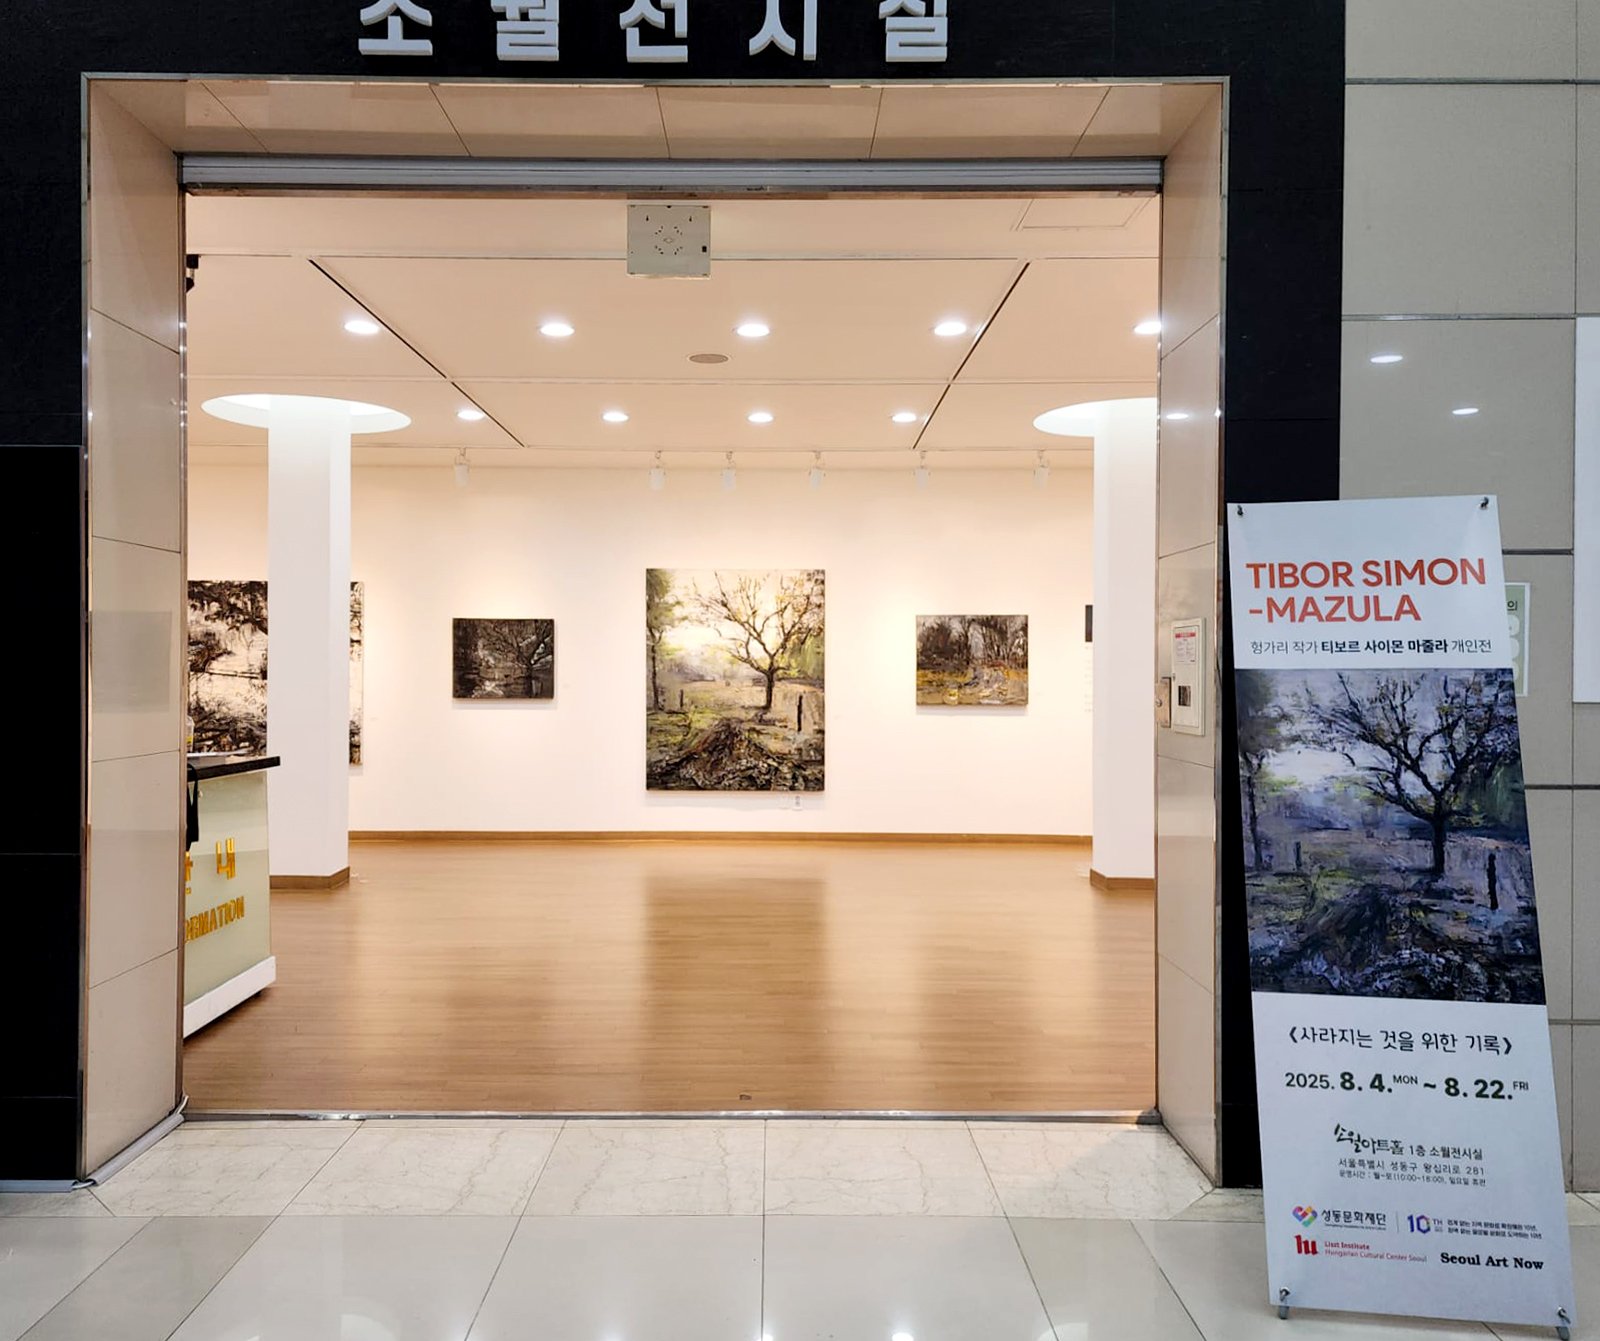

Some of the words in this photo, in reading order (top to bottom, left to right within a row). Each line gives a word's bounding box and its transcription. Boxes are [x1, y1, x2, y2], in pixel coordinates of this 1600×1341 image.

[1246, 560, 1355, 589] TIBOR
[1362, 557, 1486, 586] SIMON
[1249, 594, 1422, 623] -MAZULA
[1250, 640, 1289, 655] 헝가리
[1292, 640, 1318, 654] 작가
[1321, 639, 1361, 654] 티보르
[1364, 639, 1404, 654] 사이몬
[1408, 639, 1448, 654] 마줄라
[1451, 639, 1492, 654] 개인전
[1379, 1030, 1415, 1052] 것을
[1421, 1032, 1458, 1053] 위한
[1284, 1072, 1335, 1090] 2025.
[1393, 1075, 1418, 1085] MON
[1473, 1078, 1513, 1100] 22.
[1513, 1081, 1529, 1091] FRI
[1430, 1146, 1483, 1161] 소월전시실
[1339, 1158, 1385, 1170] 서울특별시
[1390, 1161, 1418, 1172] 성동구
[1423, 1162, 1461, 1175] 왕십리로
[1466, 1166, 1484, 1176] 281
[1321, 1209, 1386, 1226] 성동문화재단
[1440, 1252, 1481, 1266] Seoul
[1485, 1255, 1509, 1268] Art
[1513, 1257, 1544, 1270] Now
